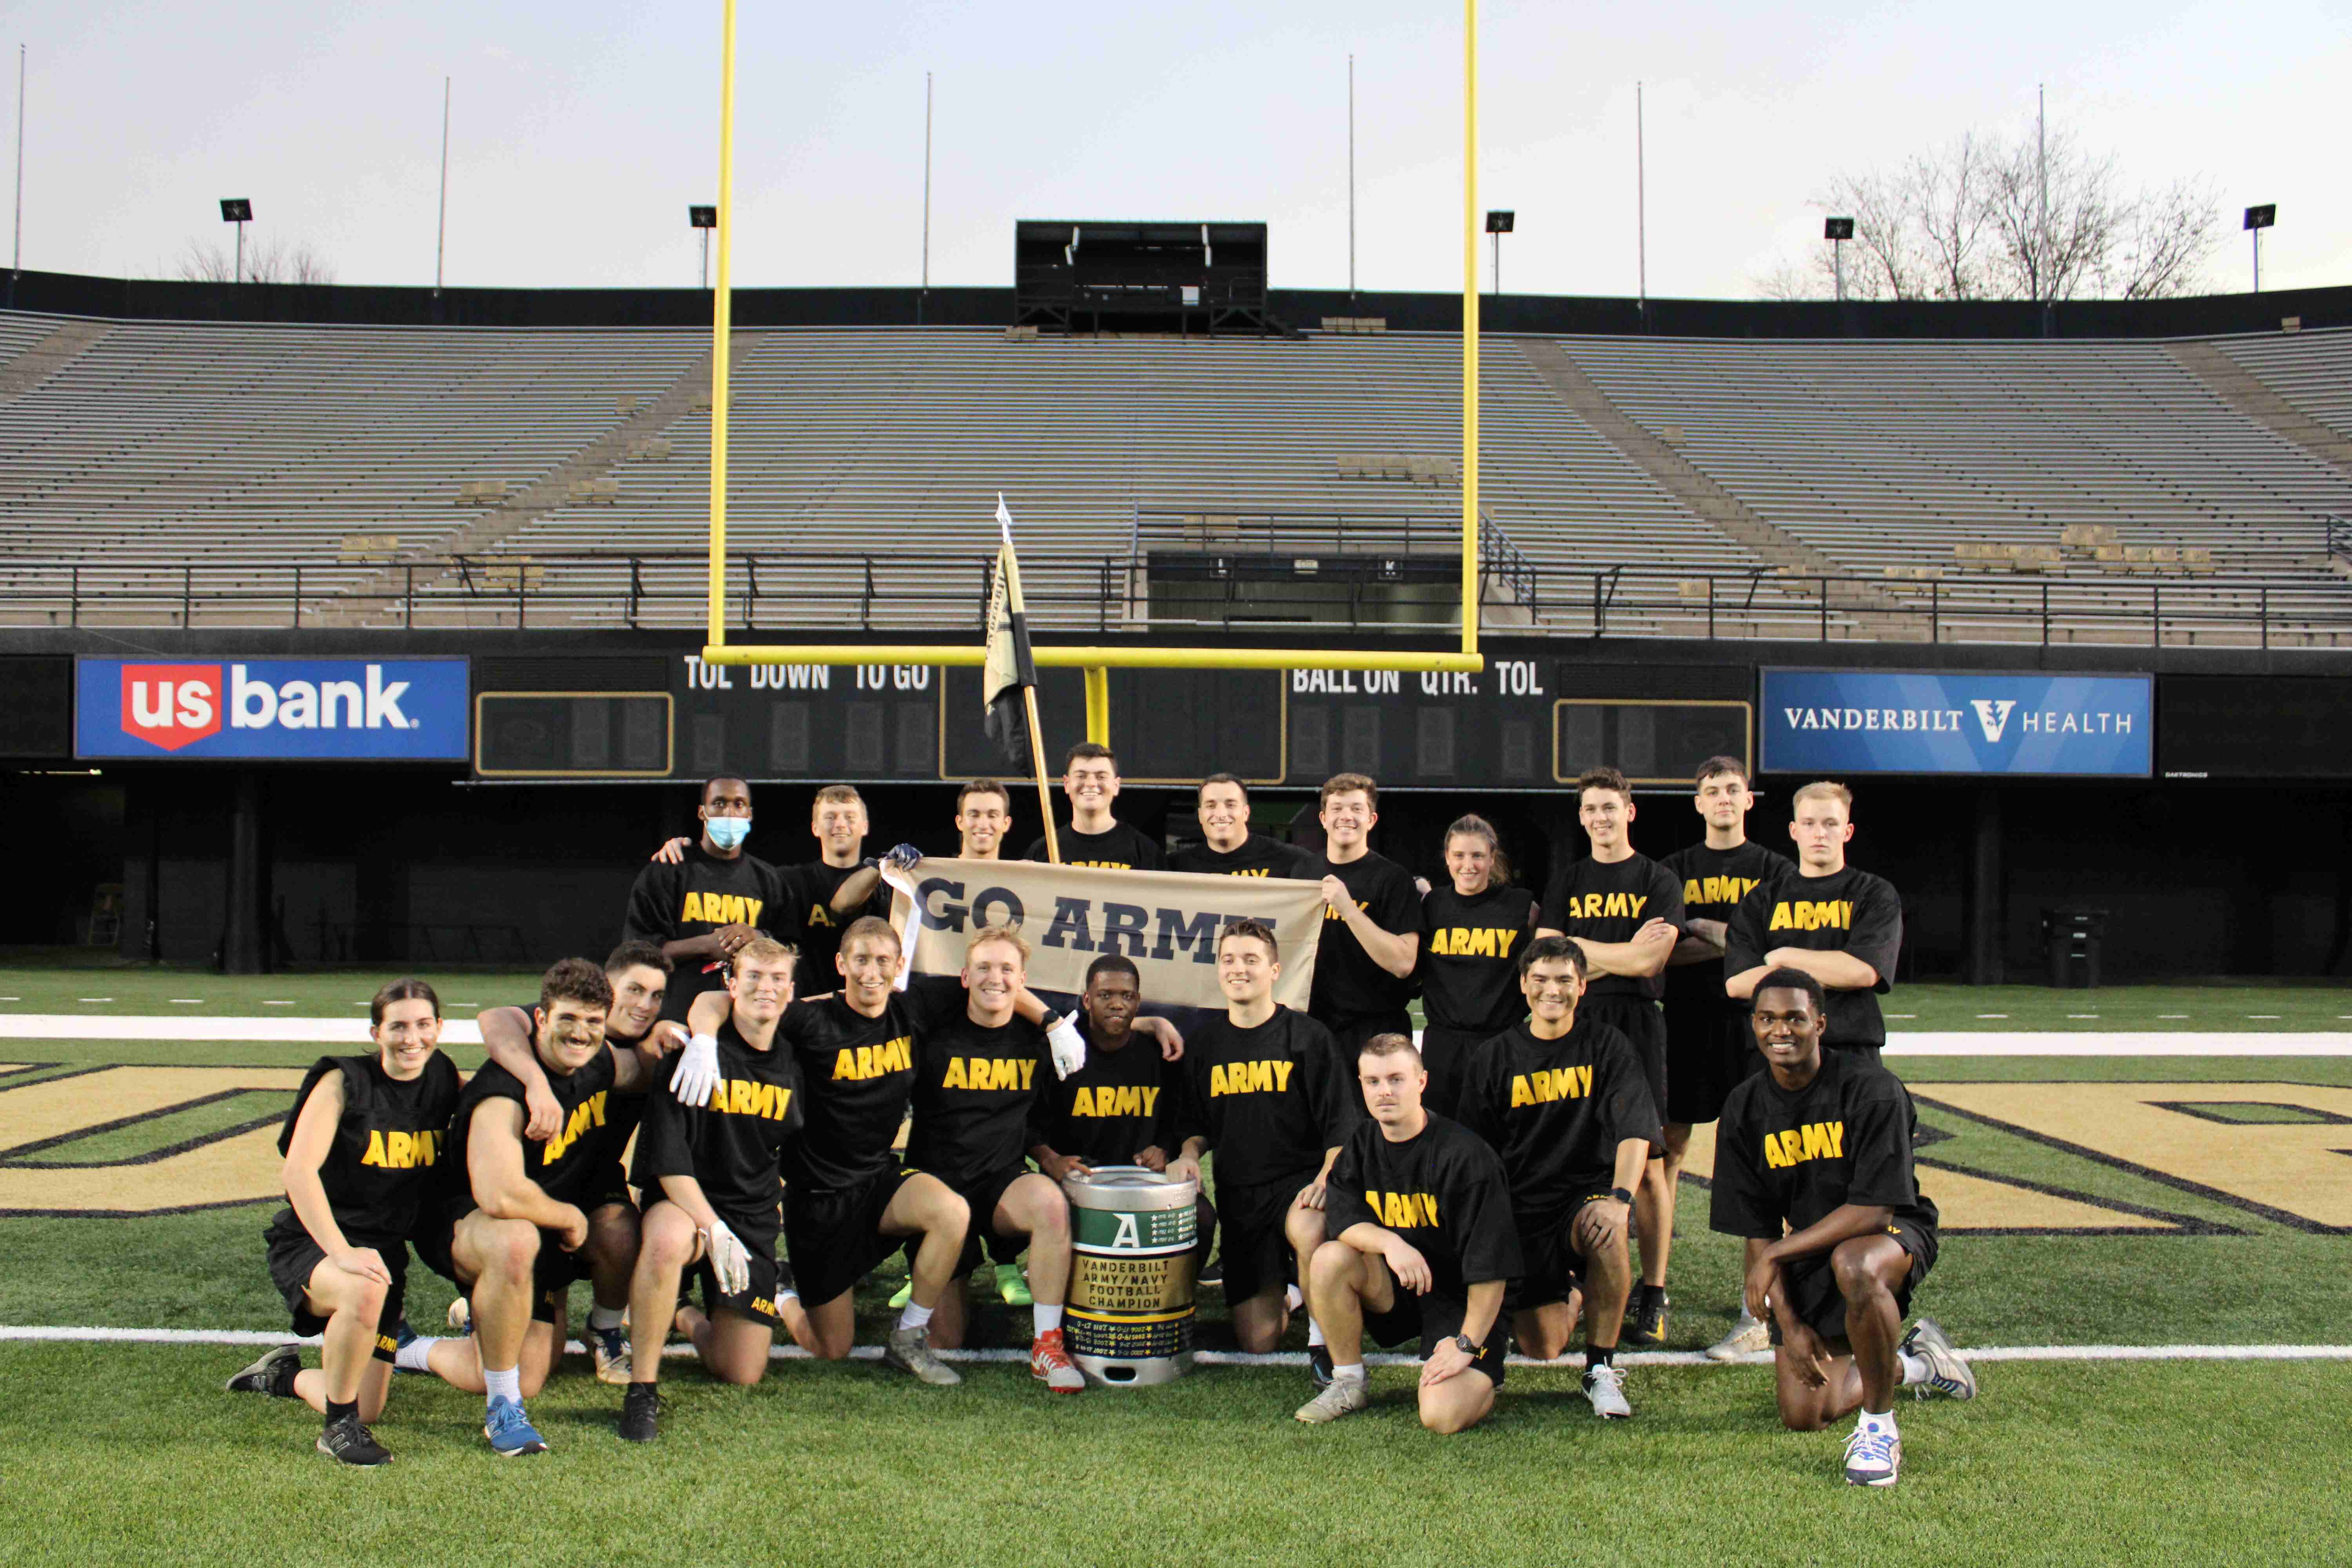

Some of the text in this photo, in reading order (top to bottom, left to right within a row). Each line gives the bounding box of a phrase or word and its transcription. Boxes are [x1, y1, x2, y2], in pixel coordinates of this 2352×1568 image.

[684, 655, 733, 689] TOL
[750, 665, 829, 689] DOWN
[1293, 669, 1399, 693] BALL ON
[1495, 661, 1543, 695] TOL
[132, 681, 213, 728] us
[1784, 708, 1963, 730] VANDERBILT
[2023, 712, 2131, 733] HEALTH
[682, 892, 763, 928] ARMY
[915, 877, 1024, 933] GO
[1570, 893, 1647, 919] ARMY
[1769, 899, 1853, 931] ARMY
[1429, 928, 1518, 958] ARMY
[832, 1036, 912, 1081] ARMY
[942, 1057, 1037, 1091] ARMY
[1210, 1060, 1294, 1097] ARMY
[1511, 1065, 1592, 1108] ARMY
[710, 1079, 792, 1121] ARMY
[1072, 1086, 1160, 1117] ARMY
[1764, 1121, 1843, 1169] ARMY
[1112, 1213, 1140, 1248] A
[1082, 1260, 1169, 1273] VANDERBILT
[1083, 1273, 1168, 1285] ARMY/NAVY
[1089, 1285, 1160, 1296] FOOTBALL
[1089, 1296, 1160, 1308] CHAMPION
